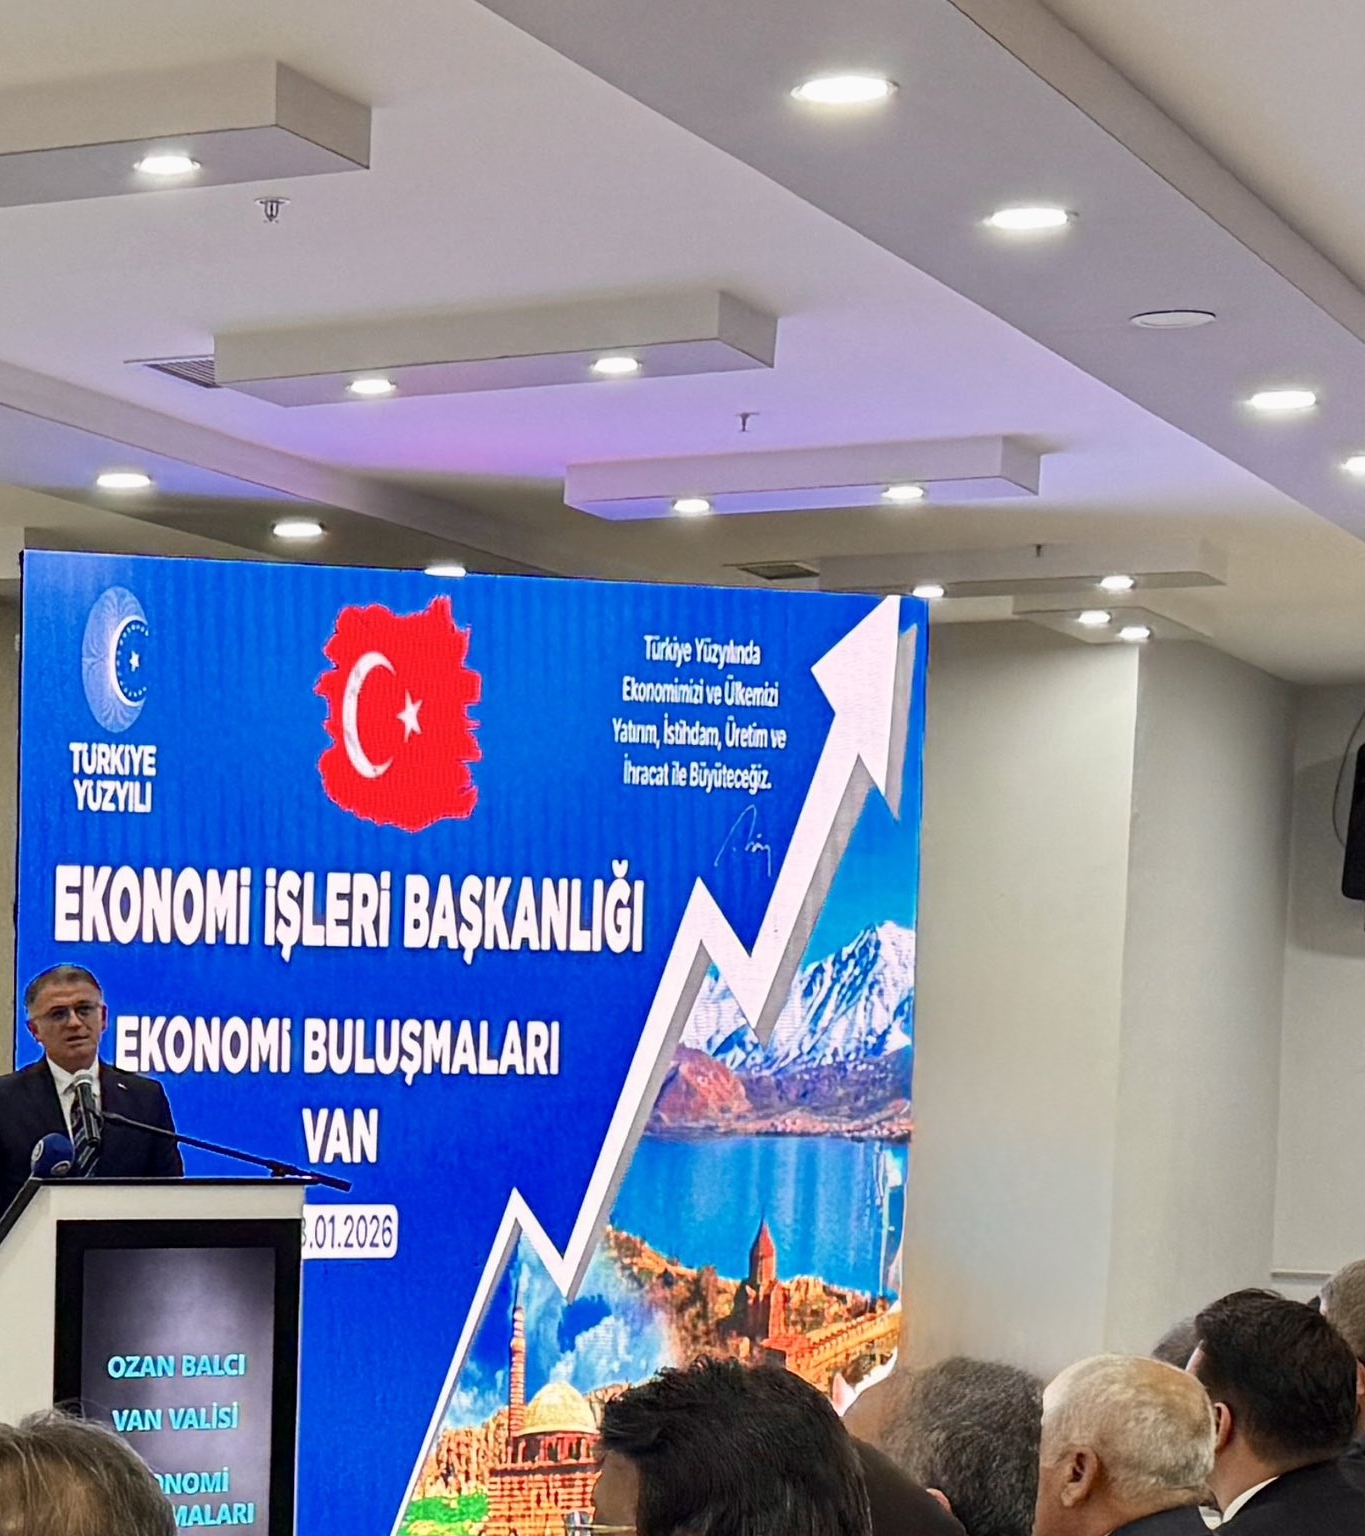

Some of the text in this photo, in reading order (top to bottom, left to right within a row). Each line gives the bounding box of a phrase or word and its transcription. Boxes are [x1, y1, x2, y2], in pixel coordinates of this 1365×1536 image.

[622, 674, 779, 707] Ekonomimizi ve Ülkemizi
[663, 713, 721, 751] İstihdam,
[725, 715, 768, 748] Üretim
[771, 728, 787, 749] ve
[623, 753, 668, 785] İhracat
[672, 761, 687, 786] ile
[55, 860, 643, 964] EKONOMİ İŞLERİ BAŞKANLIĞI
[117, 1015, 559, 1085] EKONOMİ BULUŞMALARI
[302, 1108, 377, 1163] VAN
[107, 1354, 246, 1378] OZAN BALCI
[112, 1401, 239, 1431] VAN VALİSİ
